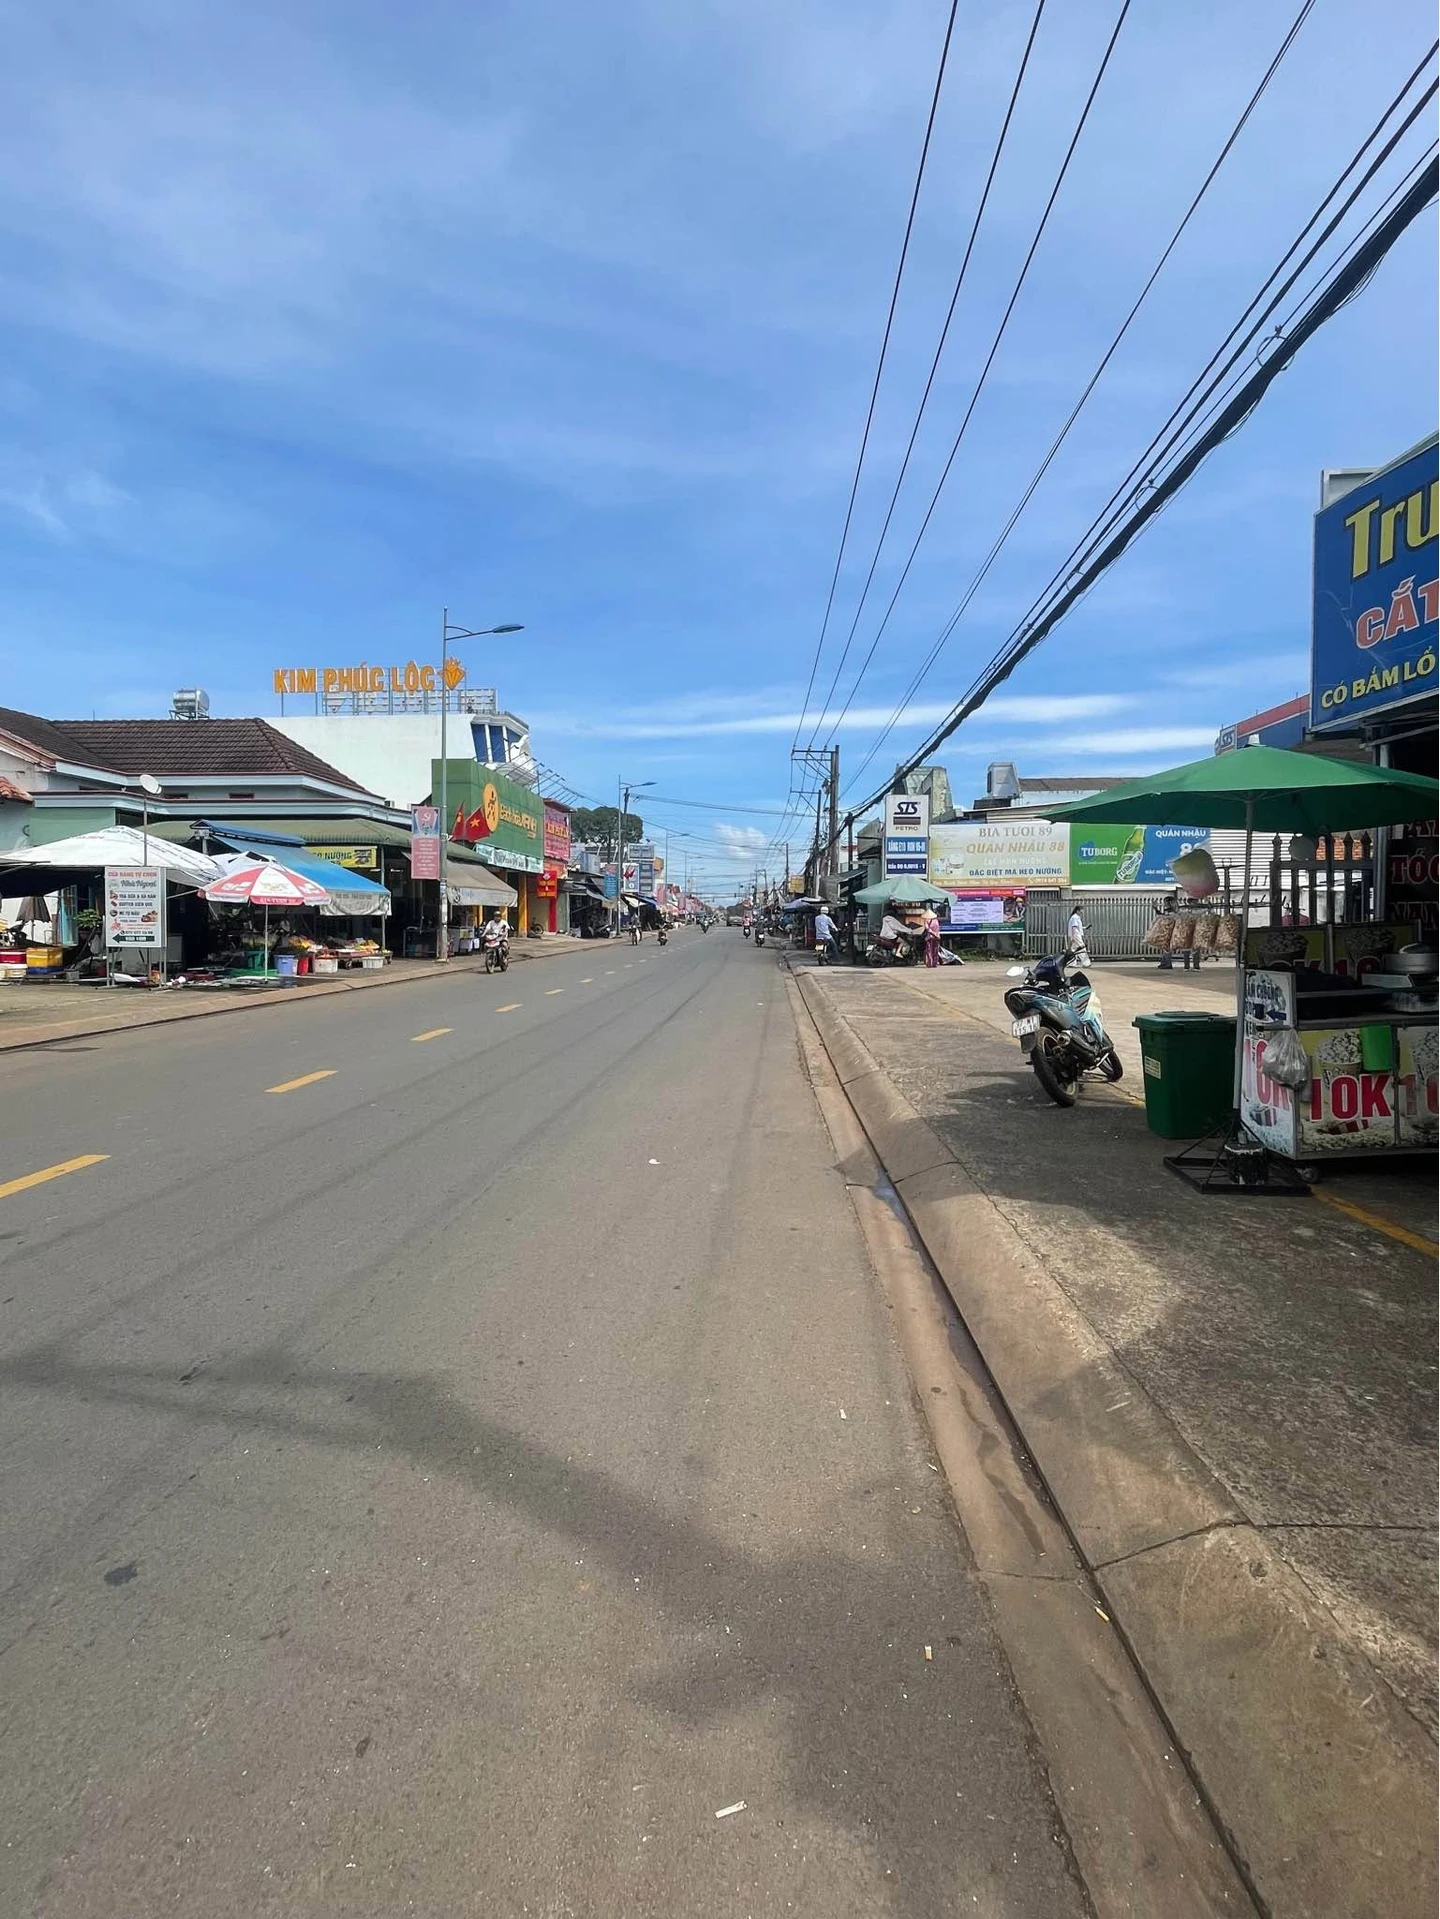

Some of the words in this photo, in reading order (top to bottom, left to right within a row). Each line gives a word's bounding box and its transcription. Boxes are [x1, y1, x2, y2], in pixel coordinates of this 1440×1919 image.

[273, 667, 318, 693] KIM
[323, 661, 386, 693] PHÚC
[391, 660, 437, 696] LỘC
[893, 802, 919, 815] STS
[980, 827, 1000, 837] BIA
[1038, 826, 1053, 836] 89
[1155, 828, 1180, 838] QUÁN
[1182, 828, 1206, 839] NHẬU
[1080, 847, 1118, 857] TUBORG
